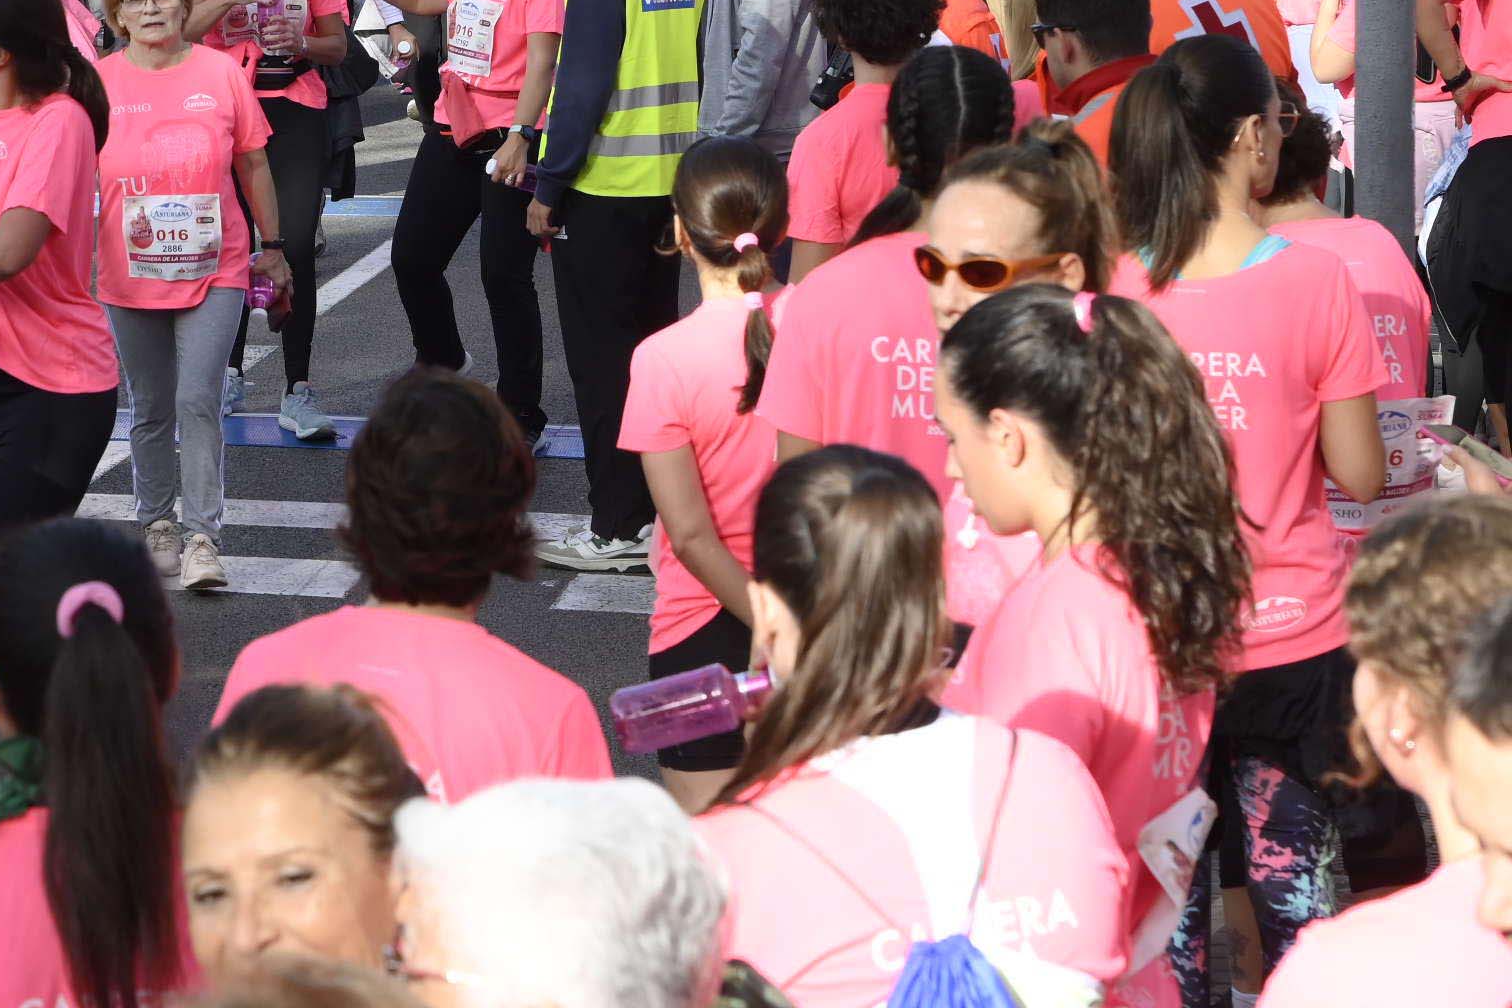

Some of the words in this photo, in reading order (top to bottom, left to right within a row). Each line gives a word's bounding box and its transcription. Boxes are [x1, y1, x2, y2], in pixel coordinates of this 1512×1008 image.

[112, 102, 152, 116] OYSHO
[117, 175, 148, 196] TU
[154, 209, 190, 219] ASTURIANA
[156, 229, 189, 241] 016
[162, 244, 183, 253] 2886
